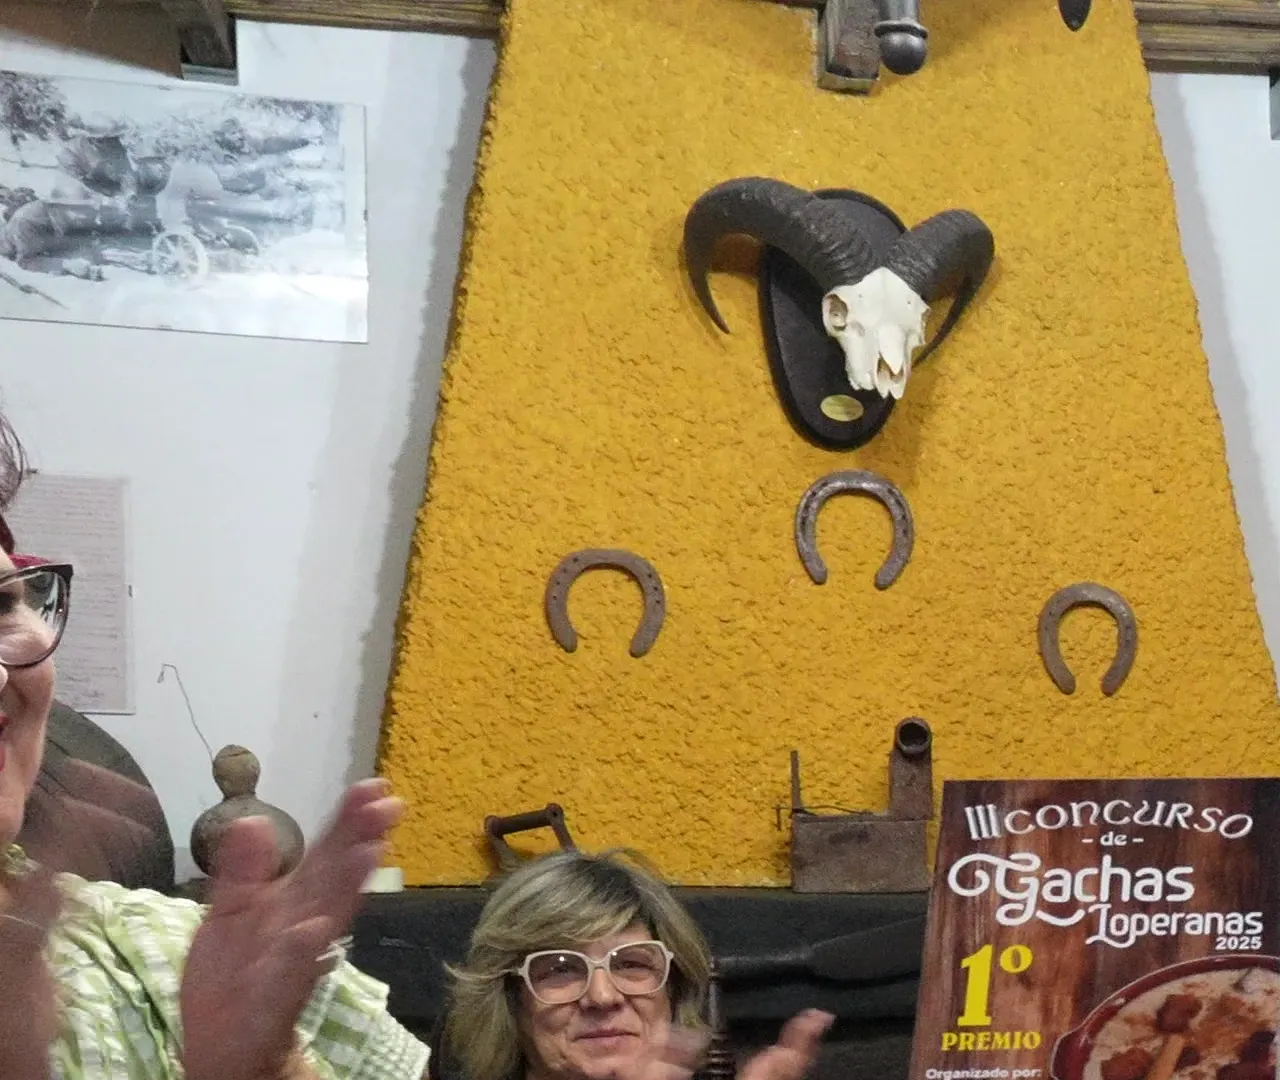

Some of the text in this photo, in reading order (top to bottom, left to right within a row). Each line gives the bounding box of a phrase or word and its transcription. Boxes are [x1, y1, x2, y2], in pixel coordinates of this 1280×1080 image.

[964, 800, 1253, 841] III CONCURSO
[948, 852, 1195, 926] Gachas
[1085, 903, 1263, 948] Loperanas
[1215, 936, 1262, 950] 2025
[941, 1031, 1042, 1051] PREMIO
[1012, 1068, 1042, 1080] por:
